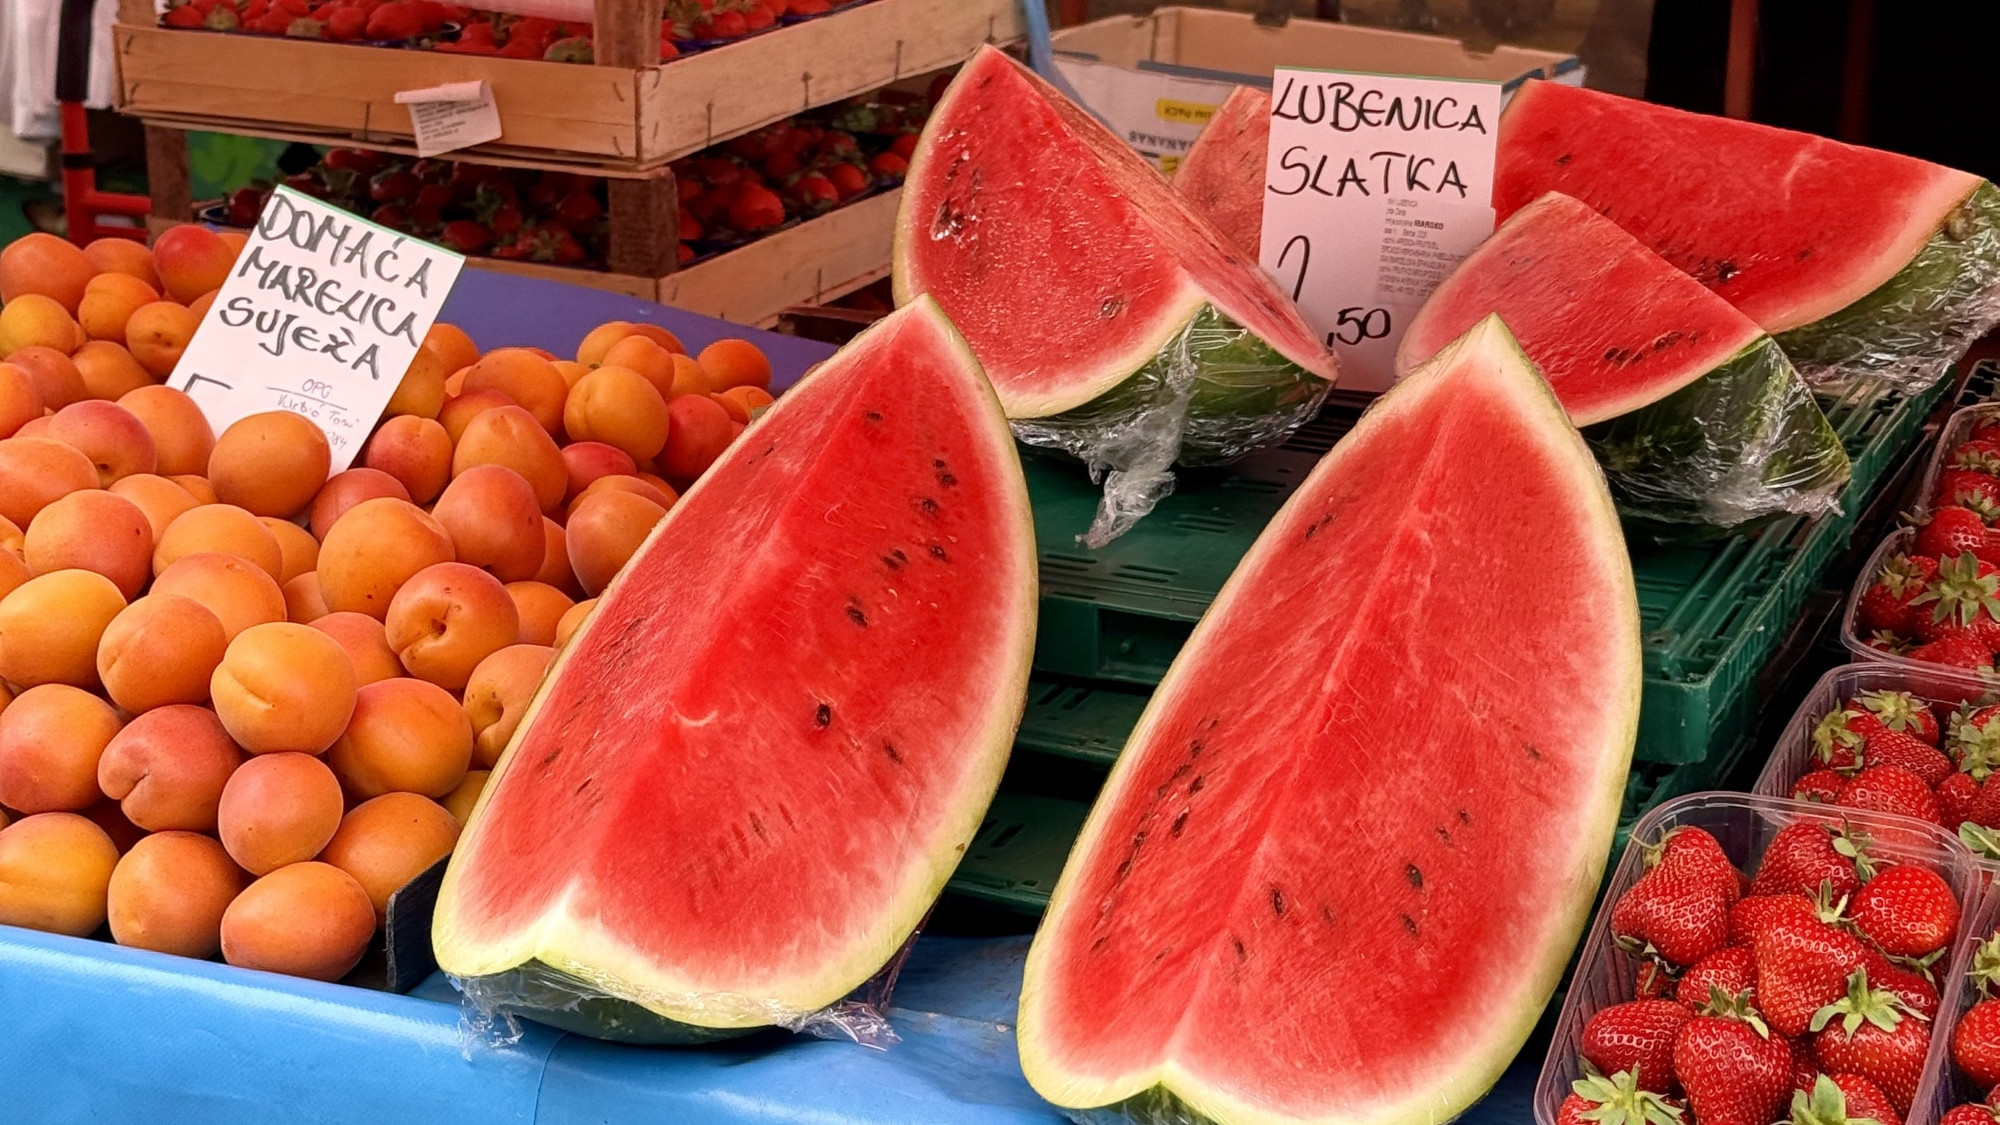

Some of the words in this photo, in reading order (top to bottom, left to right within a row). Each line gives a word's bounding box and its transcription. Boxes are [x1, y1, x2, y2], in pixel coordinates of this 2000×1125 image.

[1271, 77, 1487, 135] LUBENICA
[1128, 131, 1194, 151] ANANAS
[1267, 145, 1469, 199] SLATKA
[257, 193, 433, 299] DOMAĆA
[237, 246, 419, 349] MARELICA
